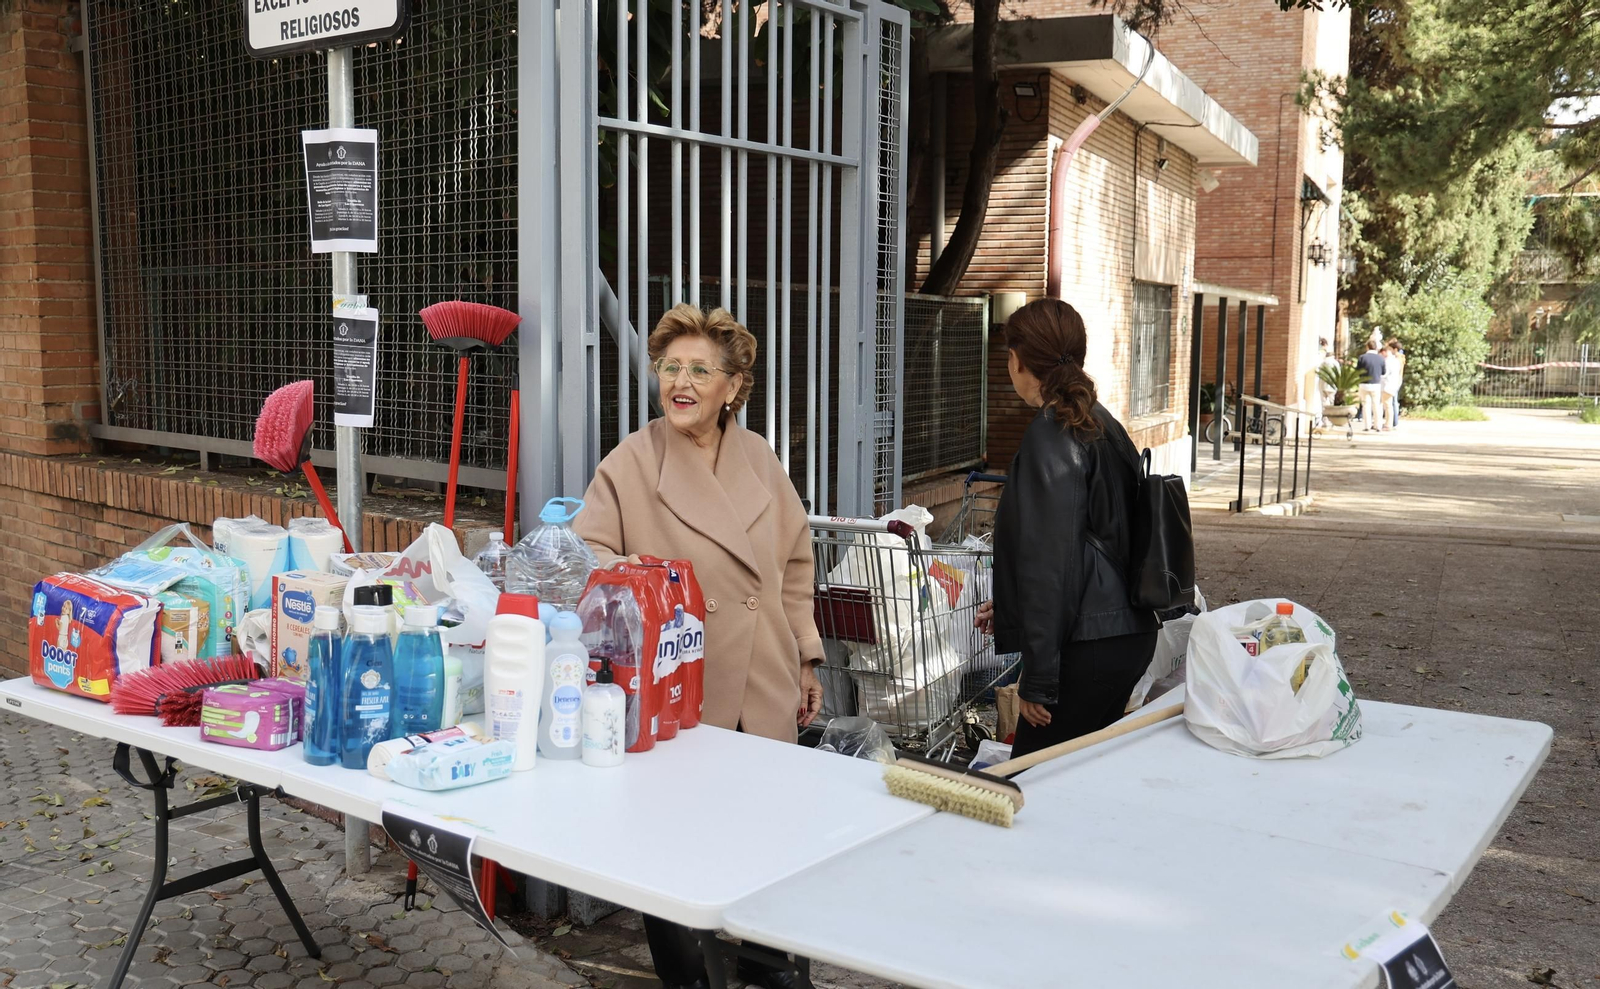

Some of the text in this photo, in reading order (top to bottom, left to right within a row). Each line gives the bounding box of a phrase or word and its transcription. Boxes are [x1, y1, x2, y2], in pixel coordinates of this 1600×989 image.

[280, 7, 360, 41] RELIGIOSOS
[285, 597, 313, 614] Nestlé
[290, 624, 311, 635] CEREALES
[42, 640, 77, 668] DODOT
[48, 663, 71, 677] pants
[451, 762, 476, 780] BABY
